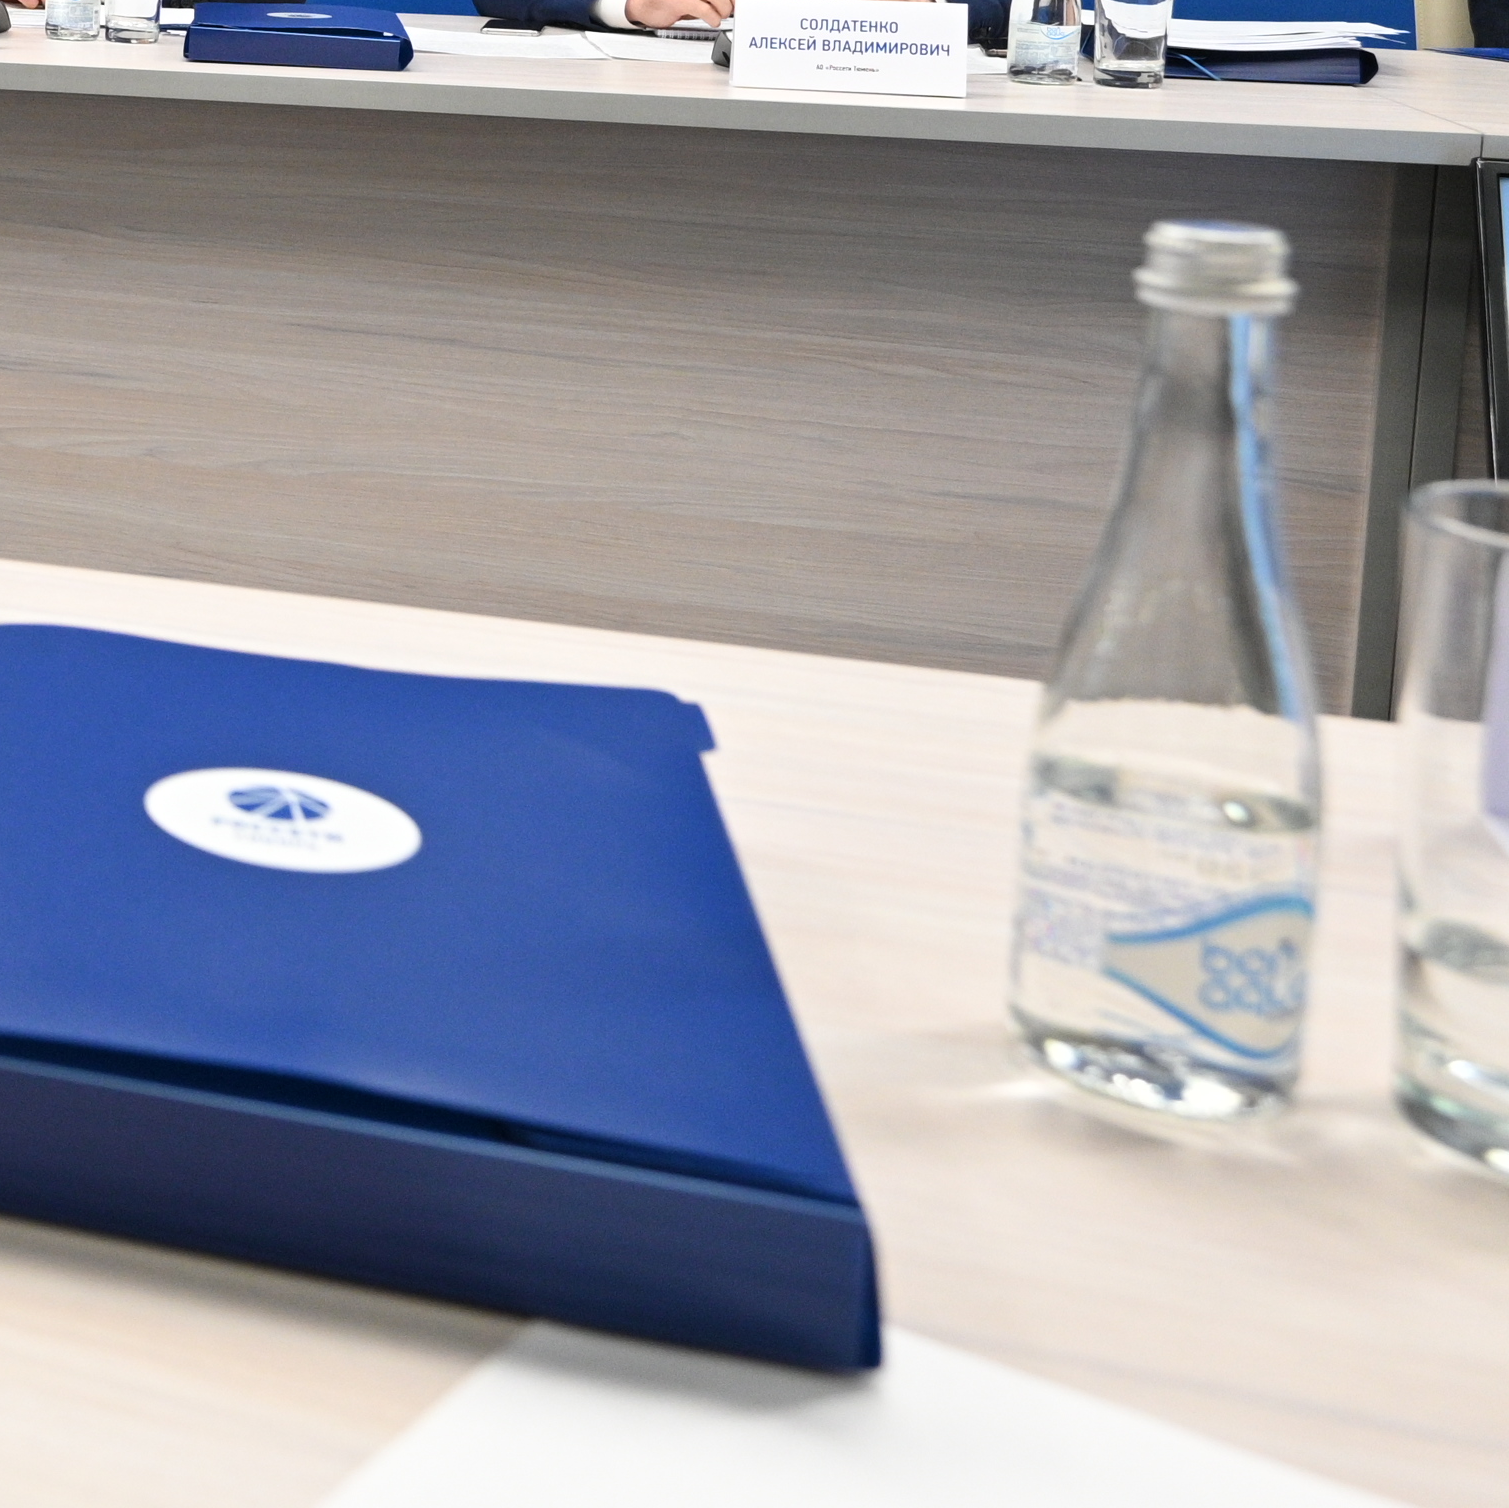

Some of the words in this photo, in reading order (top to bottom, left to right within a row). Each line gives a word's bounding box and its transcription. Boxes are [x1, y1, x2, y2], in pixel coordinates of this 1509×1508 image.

[799, 18, 899, 36] СОЛДАТЕНКО
[748, 34, 817, 53] АЛЕКСЕЙ
[821, 38, 951, 58] ВЛАДИМИРОВИЧ
